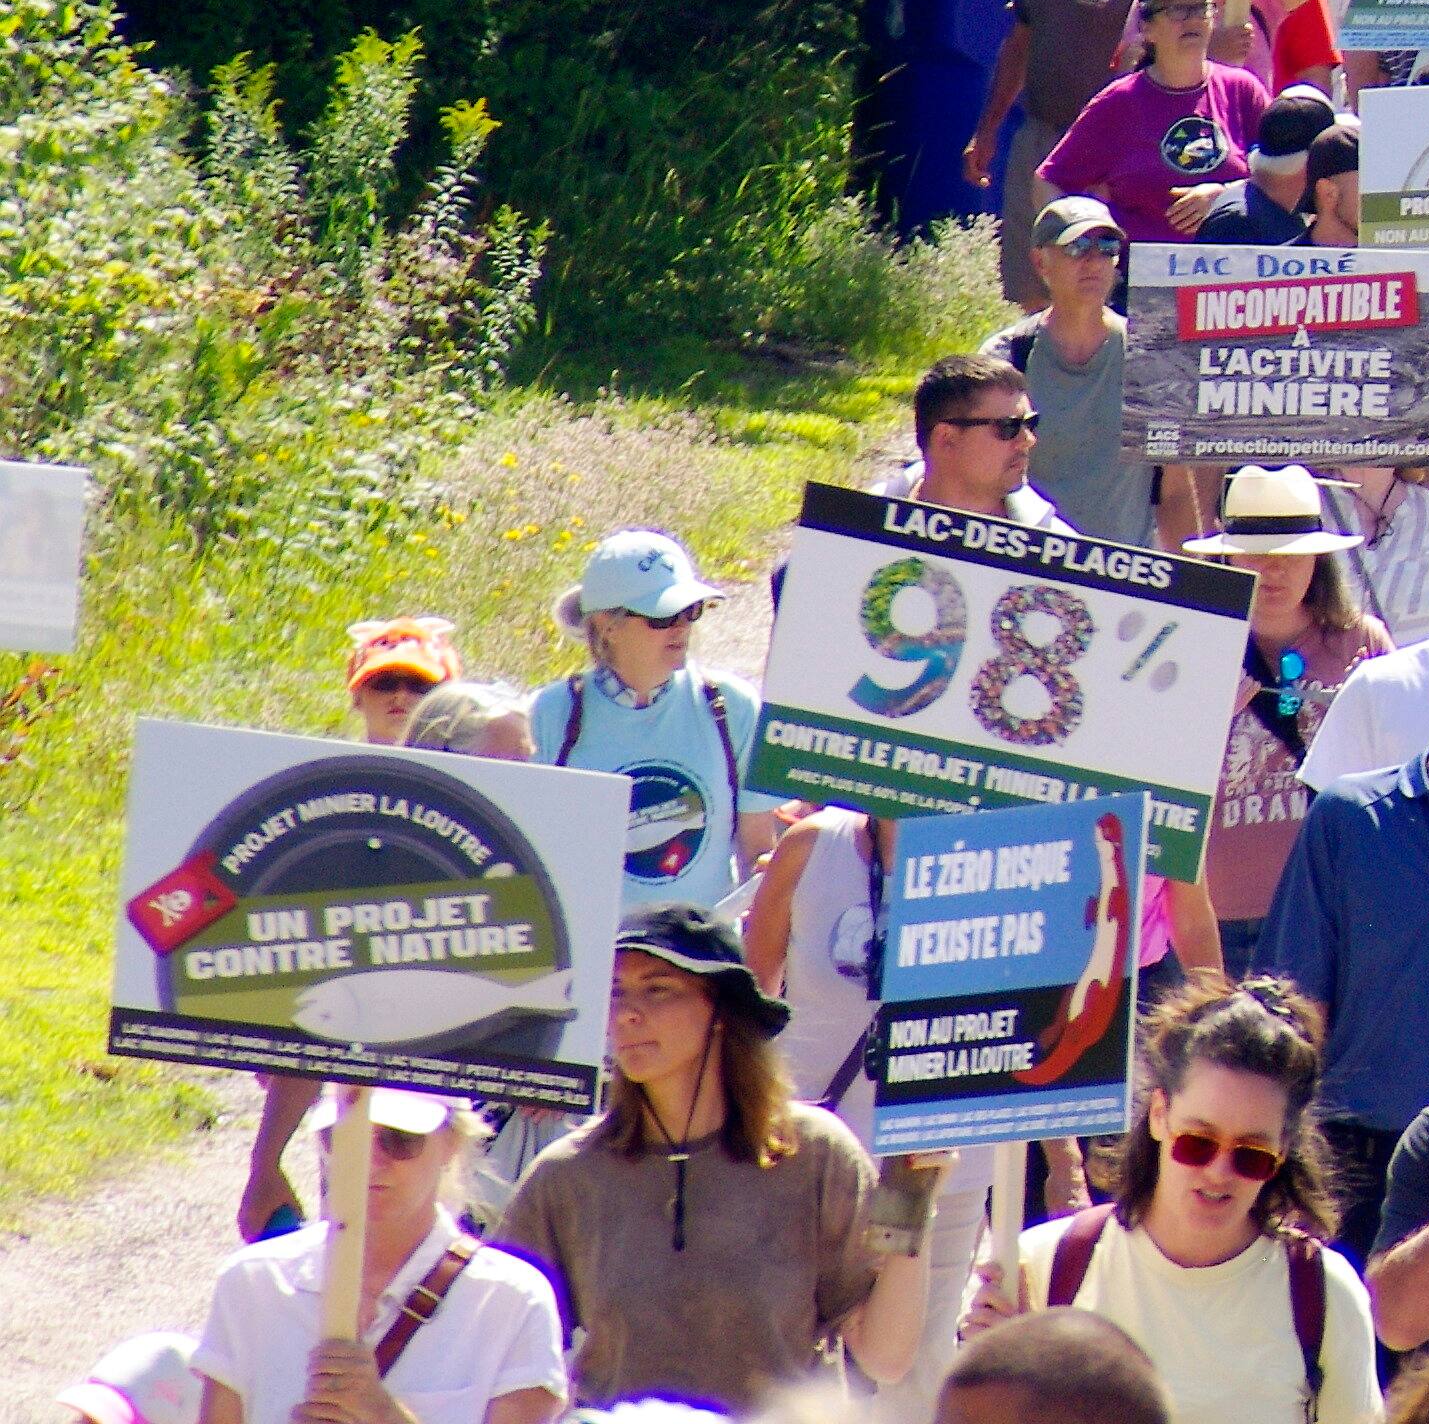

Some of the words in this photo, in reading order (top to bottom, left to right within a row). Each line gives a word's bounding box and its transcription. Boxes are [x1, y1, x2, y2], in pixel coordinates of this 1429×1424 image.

[1374, 229, 1407, 243] NON
[1168, 253, 1231, 277] LAC
[1257, 251, 1357, 279] DORÉ
[1195, 280, 1402, 332] INCOMPATIBLE
[1292, 324, 1311, 348] À
[1200, 347, 1392, 378] L'ACTIVITÉ
[1197, 378, 1391, 418] MINIÈRE
[883, 504, 1174, 589] LAC-DES-PLAGES
[766, 719, 855, 762] CONTRE
[859, 739, 892, 769] LE
[892, 746, 983, 788] PROJET
[221, 808, 298, 876] PROJET
[298, 792, 378, 823] MINIER
[380, 795, 410, 820] LA
[411, 803, 493, 867] LOUTRE
[904, 854, 936, 900] LE
[937, 839, 994, 896] ZÉRO
[996, 840, 1074, 892] RISQUE
[247, 908, 308, 942] UN
[323, 894, 491, 937] PROJET
[898, 916, 999, 968] N'EXISTE
[1002, 910, 1046, 957] PAS
[183, 937, 353, 983] CONTRE
[369, 924, 535, 965] NATURE
[890, 1016, 928, 1049] NON
[929, 1014, 952, 1043] AU
[954, 1009, 1019, 1043] PROJET
[947, 1046, 972, 1077] LA
[973, 1042, 1035, 1076] LOUTRE
